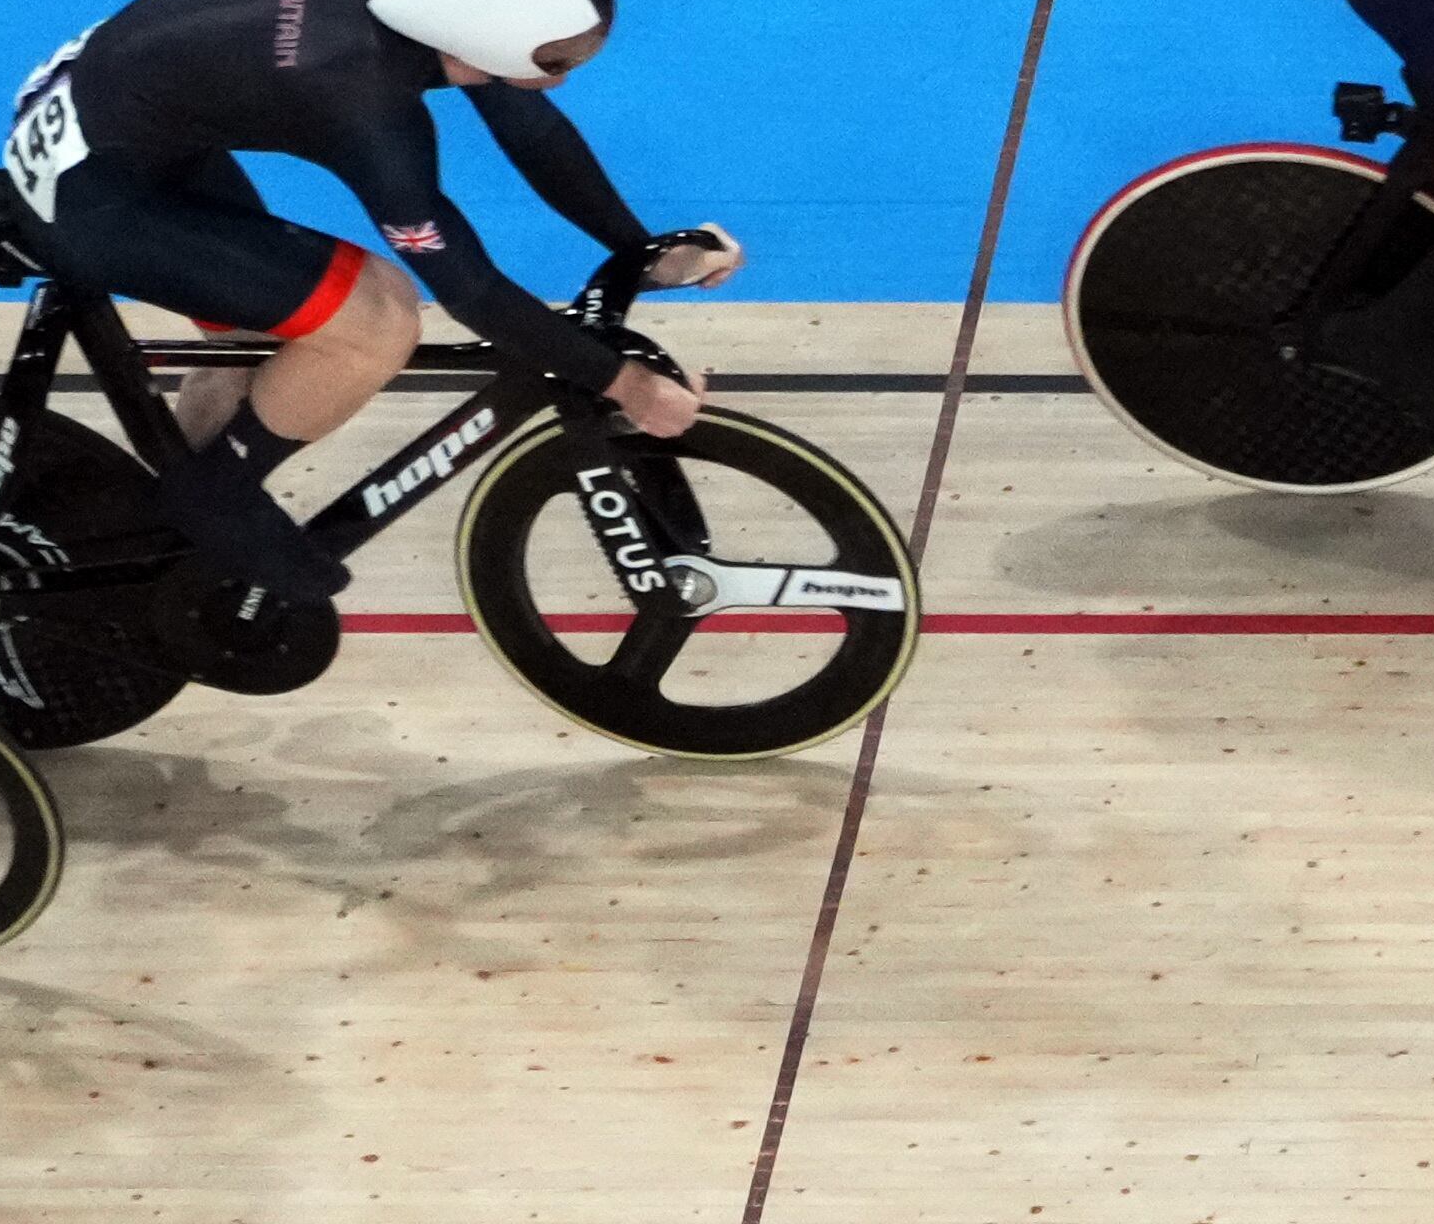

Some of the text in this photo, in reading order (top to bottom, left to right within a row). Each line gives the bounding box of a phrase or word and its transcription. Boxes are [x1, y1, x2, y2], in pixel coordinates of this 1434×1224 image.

[10, 94, 65, 194] 149
[362, 407, 496, 518] hope
[575, 466, 666, 593] LOTUS
